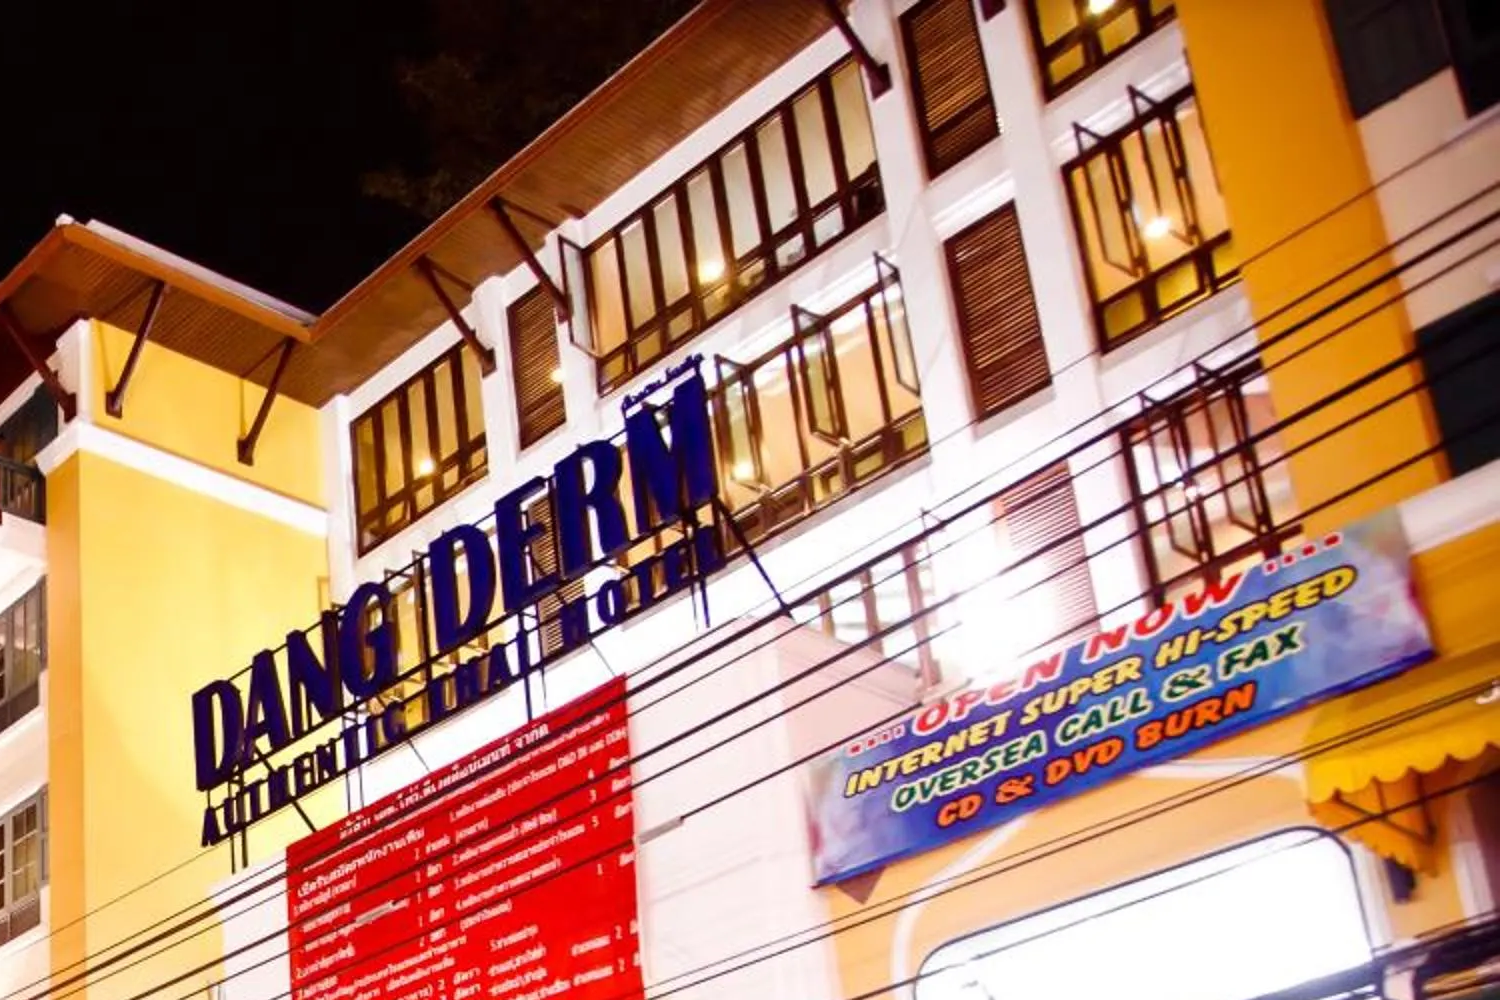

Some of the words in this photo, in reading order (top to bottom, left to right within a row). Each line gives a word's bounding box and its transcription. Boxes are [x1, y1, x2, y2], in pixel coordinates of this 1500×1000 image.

[192, 580, 399, 791] DANG
[429, 371, 718, 653] DERM
[202, 701, 407, 847] AUTHENTIC
[428, 628, 531, 722] THAI
[559, 525, 727, 652] HOTEL
[843, 710, 1009, 798] INTERNET
[1019, 656, 1143, 725] SUPER
[1154, 564, 1358, 668] HI-SPEED
[914, 650, 1067, 735] OPEN
[1086, 571, 1245, 657] NOW
[890, 735, 1045, 812] OVERSEA
[1054, 688, 1151, 746] CALL
[1164, 667, 1209, 700] &
[1222, 623, 1305, 681] FAX
[936, 790, 982, 828] CD
[995, 774, 1033, 806] &
[1045, 735, 1120, 787] DVD
[1135, 683, 1257, 749] BURN
